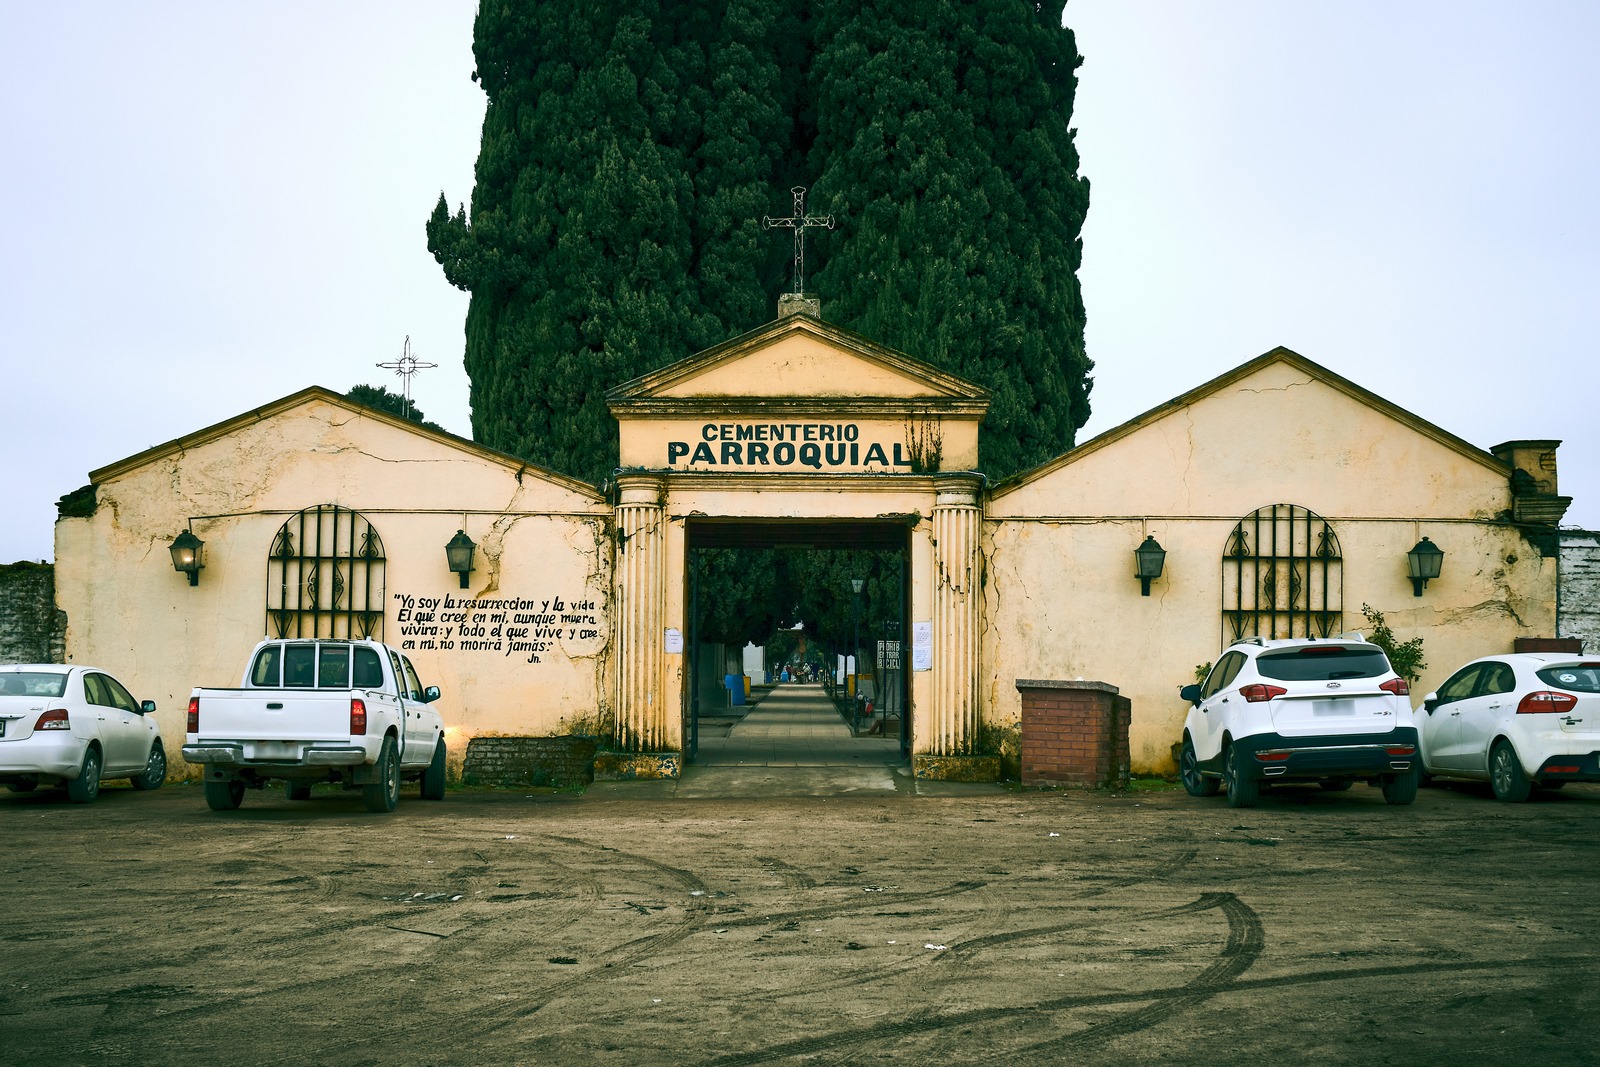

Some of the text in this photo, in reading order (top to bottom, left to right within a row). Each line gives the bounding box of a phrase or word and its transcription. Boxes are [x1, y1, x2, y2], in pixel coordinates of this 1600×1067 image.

[702, 423, 859, 442] CEMENTERIO
[668, 441, 912, 470] PARROQUIAL
[393, 592, 595, 614] "Yo soy la resurreccion y la vida
[397, 608, 412, 623] El
[413, 611, 436, 626] que
[440, 612, 468, 623] cree
[472, 613, 487, 624] en
[513, 613, 557, 628] aunque
[560, 614, 597, 625] muera
[443, 626, 454, 640] y
[458, 623, 486, 638] todo
[490, 621, 503, 638] el
[505, 627, 529, 643] que
[534, 624, 563, 640] vive
[568, 628, 576, 641] y
[579, 629, 598, 640] cree
[401, 640, 416, 651] en
[439, 640, 455, 651] no
[527, 652, 542, 664] Jn.
